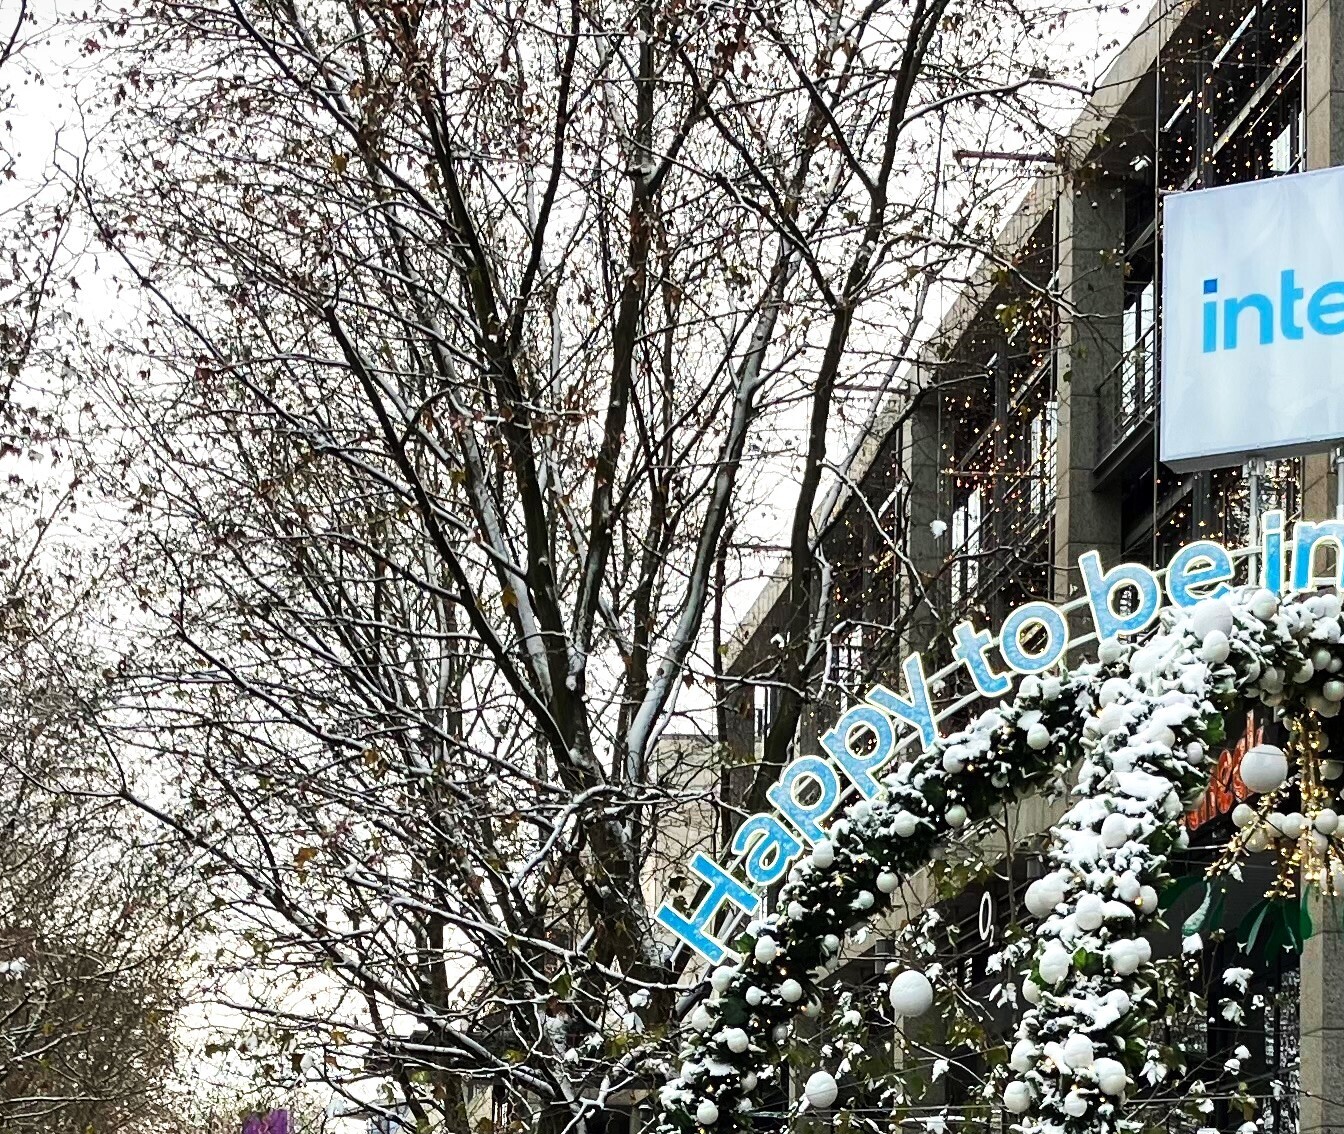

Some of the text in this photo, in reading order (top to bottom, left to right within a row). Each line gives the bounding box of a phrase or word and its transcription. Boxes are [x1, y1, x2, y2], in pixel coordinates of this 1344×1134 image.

[654, 652, 938, 966] Happy
[952, 601, 1069, 698] to
[1078, 541, 1235, 643] be
